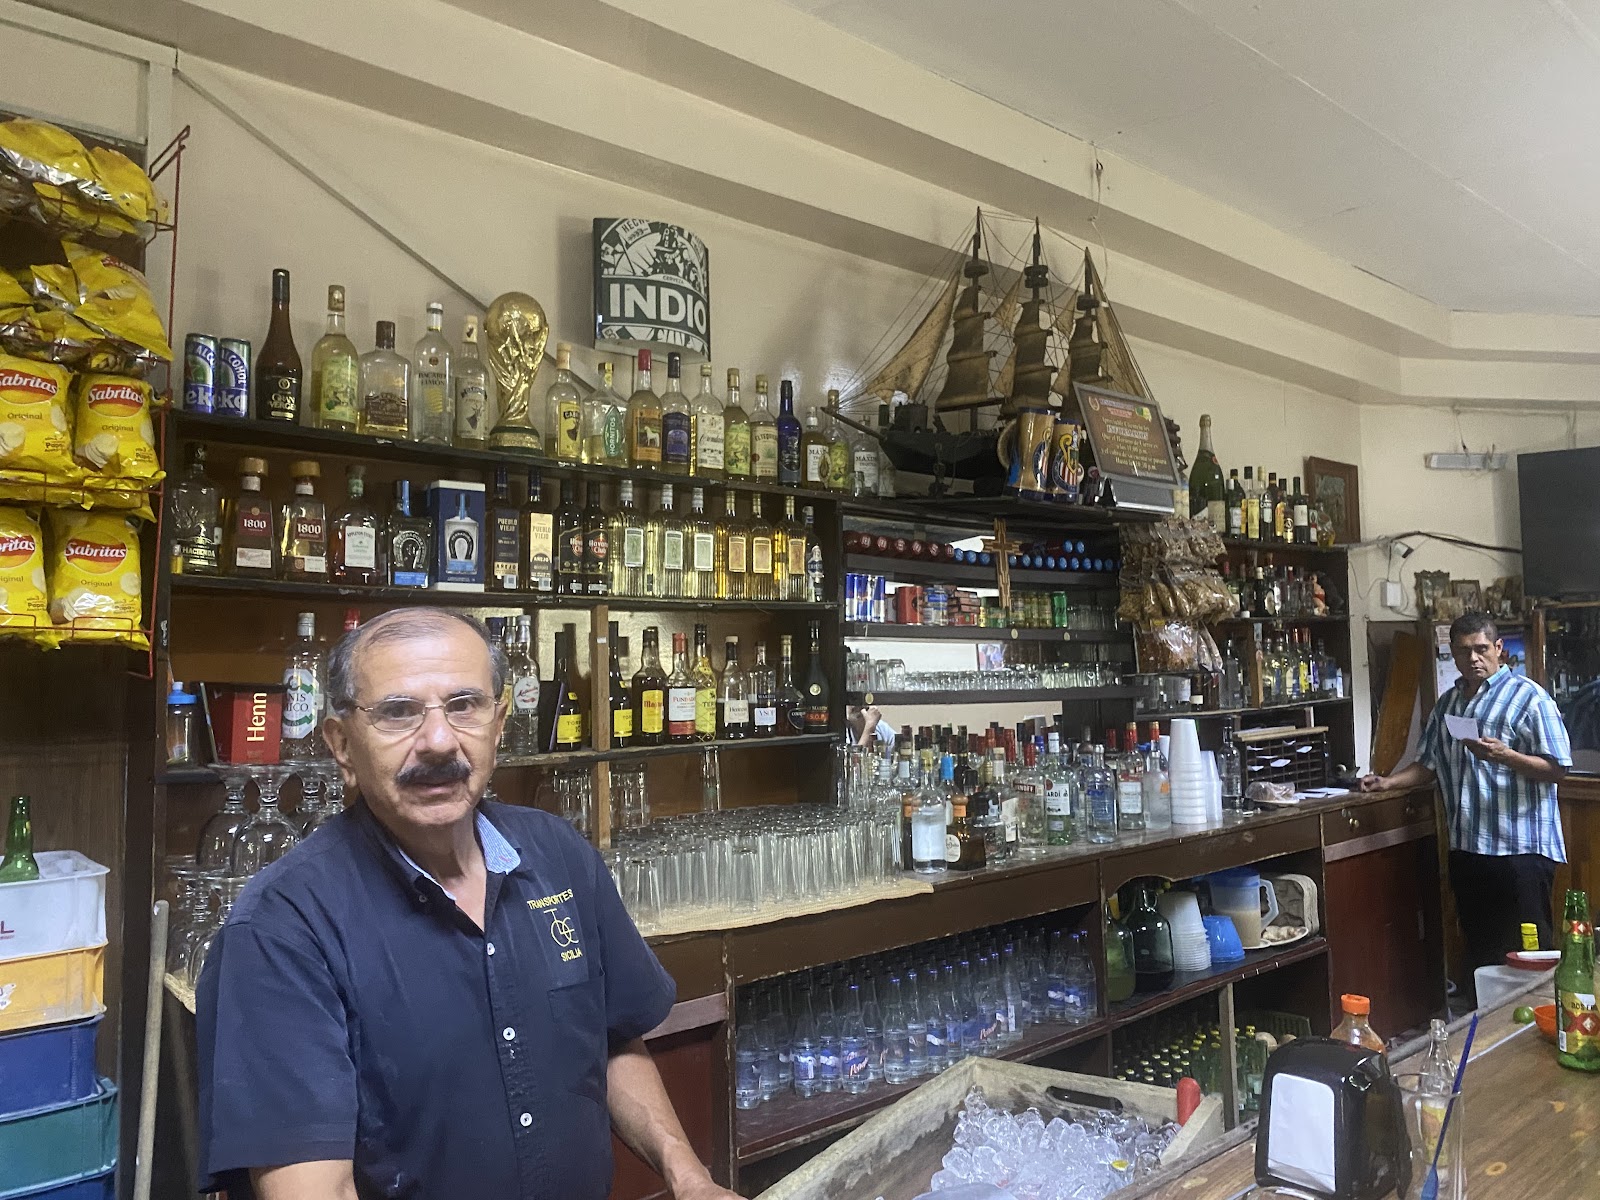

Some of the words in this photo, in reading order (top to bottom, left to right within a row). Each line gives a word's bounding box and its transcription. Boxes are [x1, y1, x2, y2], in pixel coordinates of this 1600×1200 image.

[609, 283, 707, 335] INDIO
[88, 387, 144, 404] Sabritas
[7, 413, 43, 421] Original
[101, 425, 134, 433] Original
[244, 518, 266, 529] 1800
[498, 518, 517, 526] PUEBLO
[298, 523, 321, 535] 1800
[532, 526, 551, 534] PUEBLO
[64, 542, 127, 558] Sabritas
[81, 579, 113, 587] Original
[247, 692, 267, 742] Henn
[527, 888, 574, 910] TRANSPORTES
